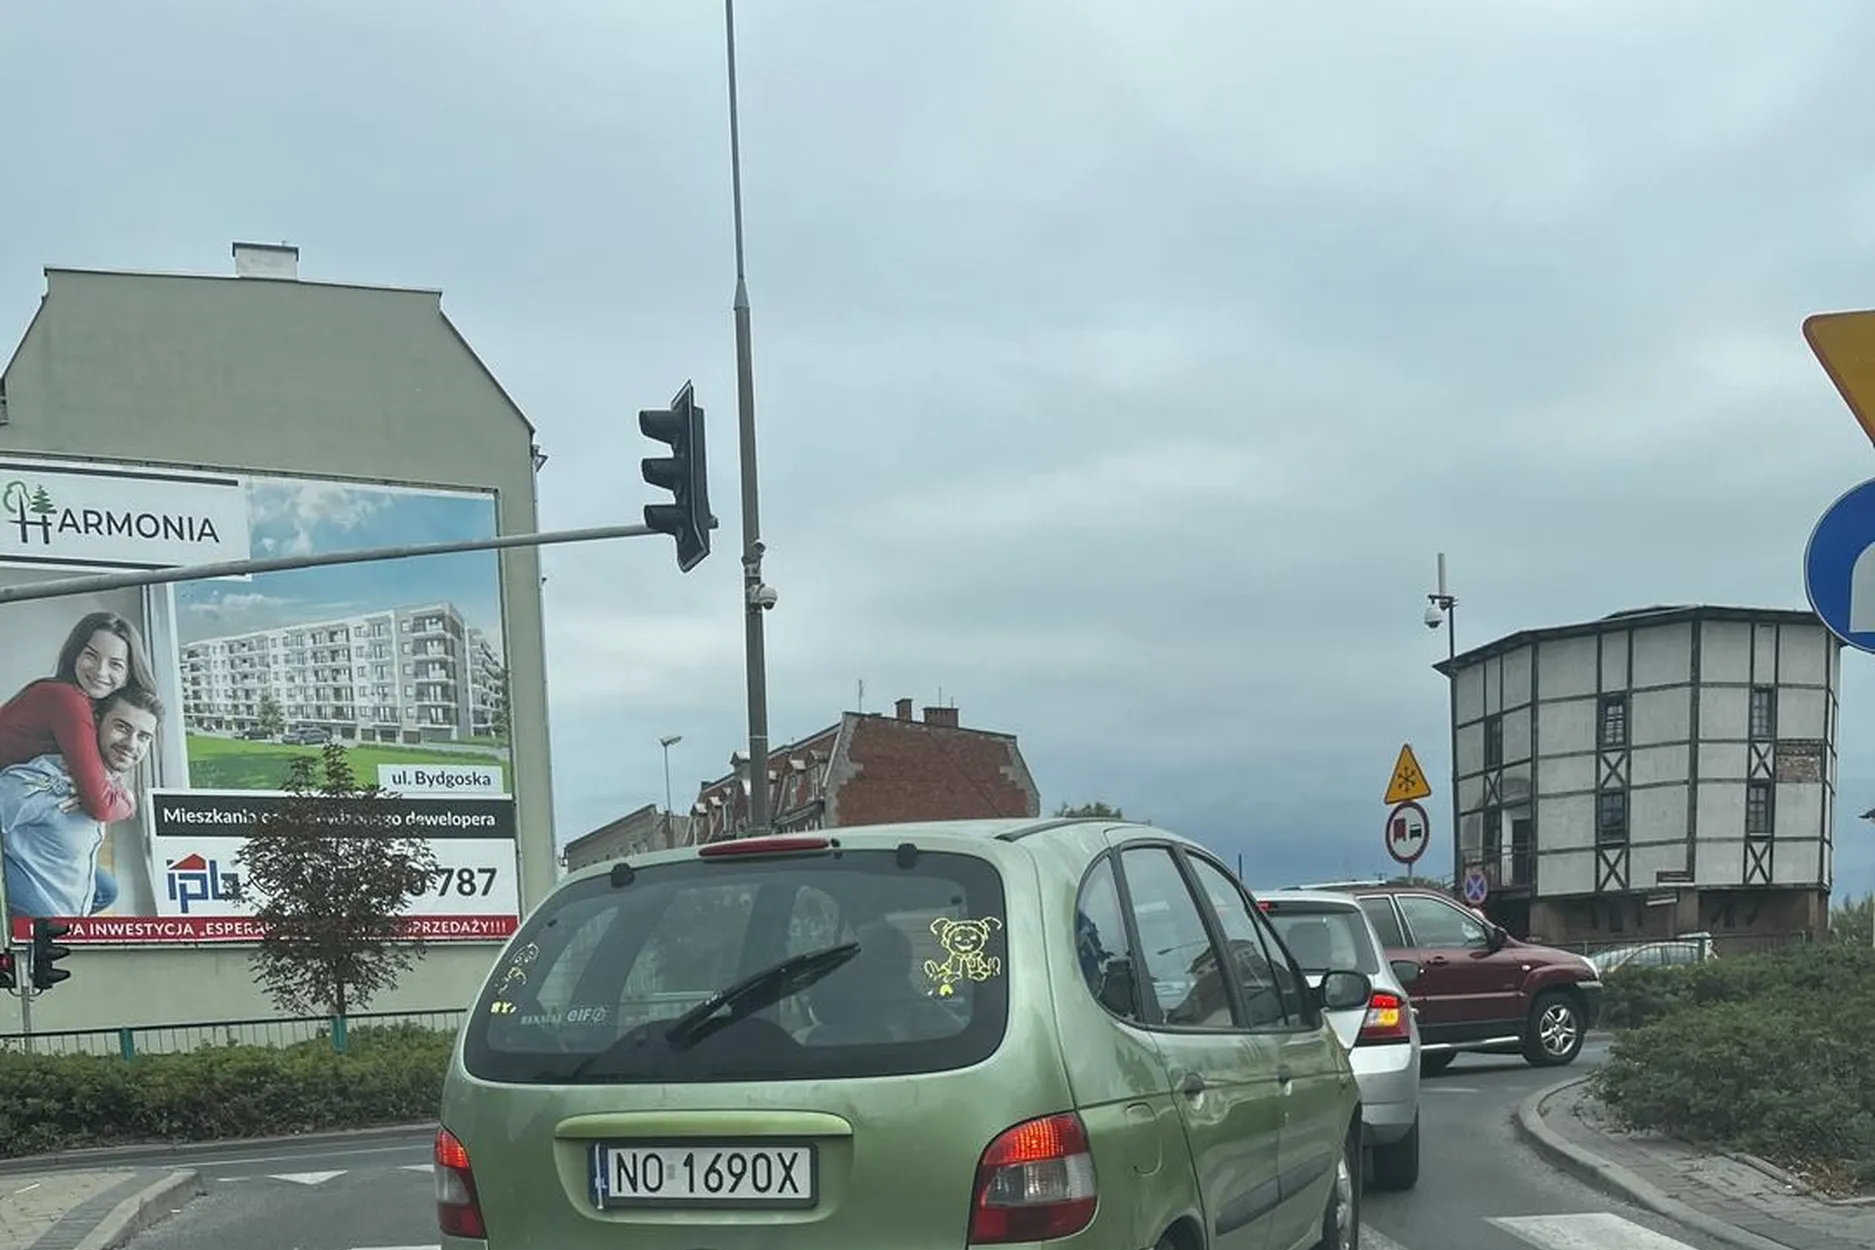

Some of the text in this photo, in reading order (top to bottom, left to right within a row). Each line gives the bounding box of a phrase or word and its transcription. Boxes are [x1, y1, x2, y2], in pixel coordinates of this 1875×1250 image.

[7, 490, 220, 544] HARMONIA
[392, 771, 492, 791] ul. Bydgoska
[90, 923, 194, 935] INWESTYCJA
[616, 1152, 799, 1193] NO 1690X
